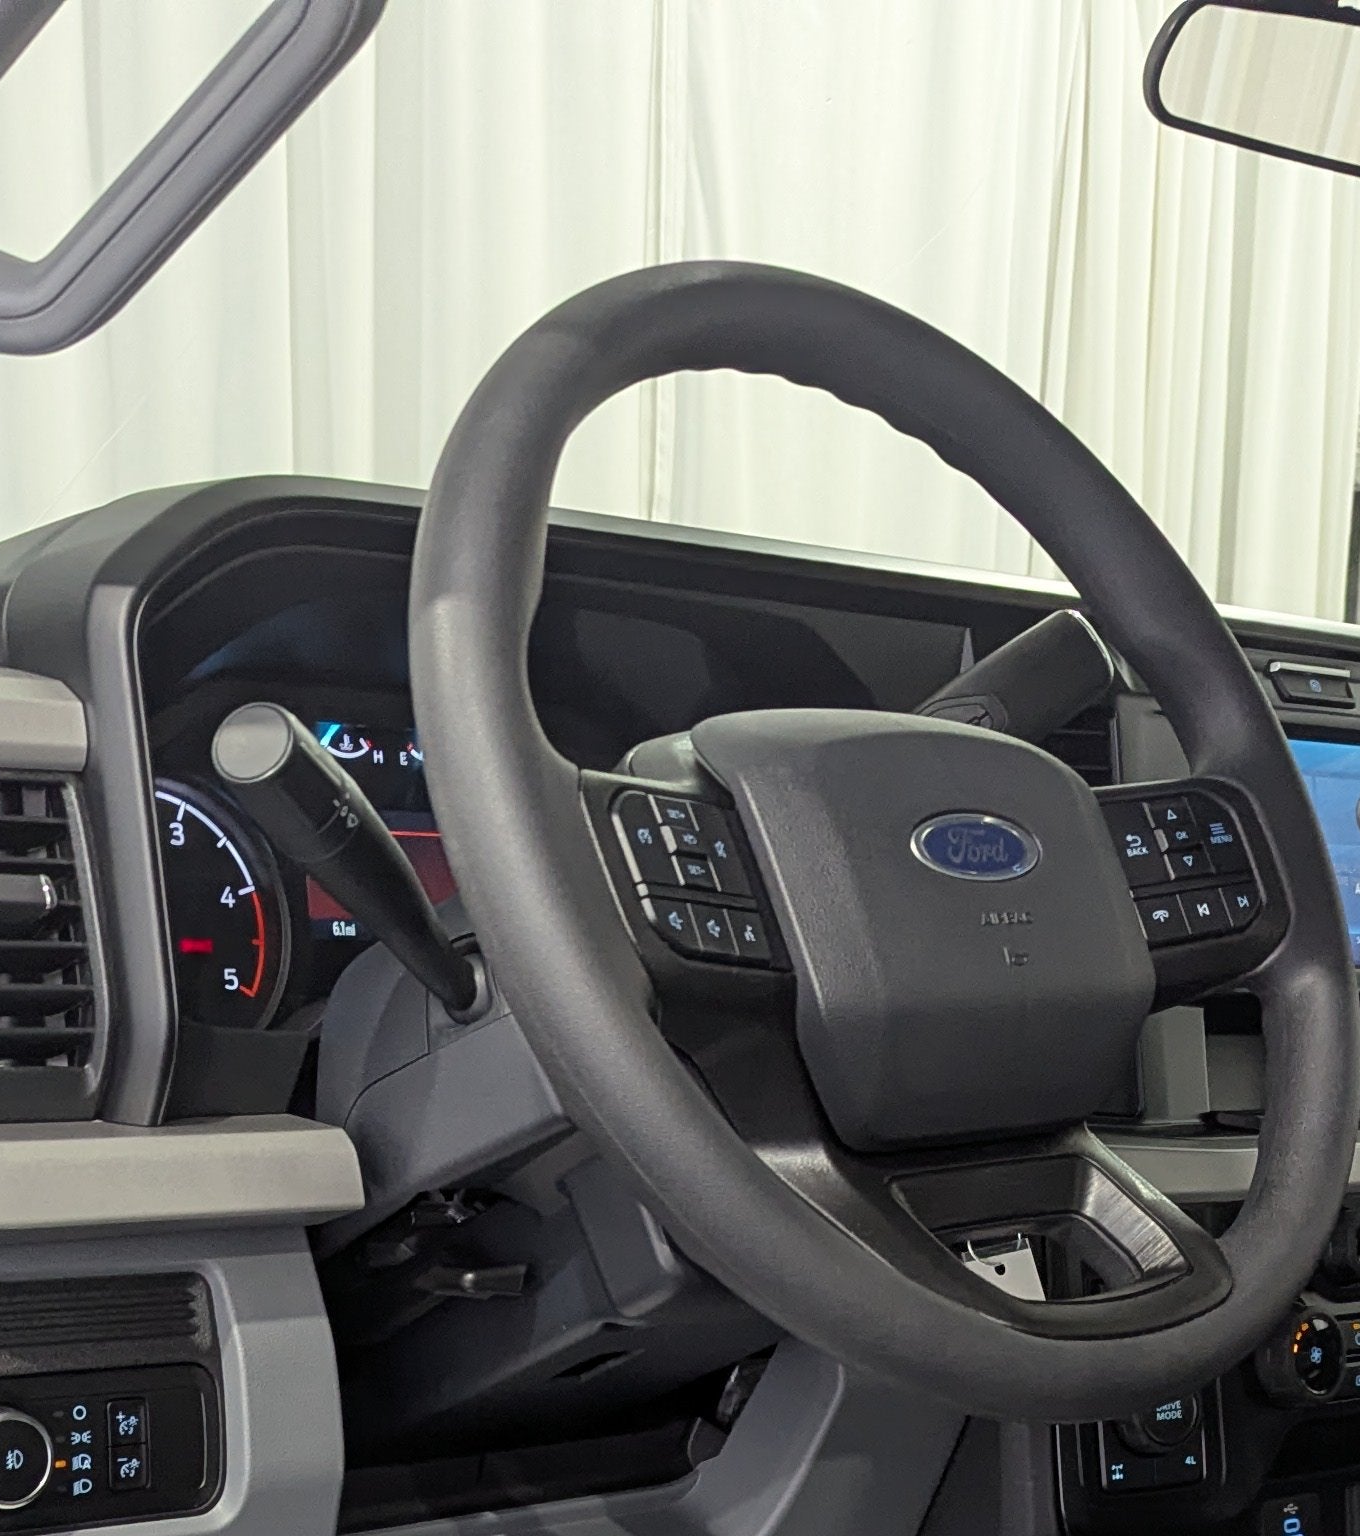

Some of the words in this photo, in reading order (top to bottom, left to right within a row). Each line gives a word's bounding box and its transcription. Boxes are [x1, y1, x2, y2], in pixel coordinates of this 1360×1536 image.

[373, 751, 384, 765] H
[400, 751, 408, 766] E
[169, 823, 185, 846] 3
[1210, 834, 1233, 844] MENU
[947, 827, 1009, 864] Ford
[1126, 846, 1149, 857] BACK
[220, 886, 236, 908] 4
[224, 968, 239, 990] 5
[1156, 1409, 1182, 1421] MODE
[1185, 1456, 1196, 1465] 4L
